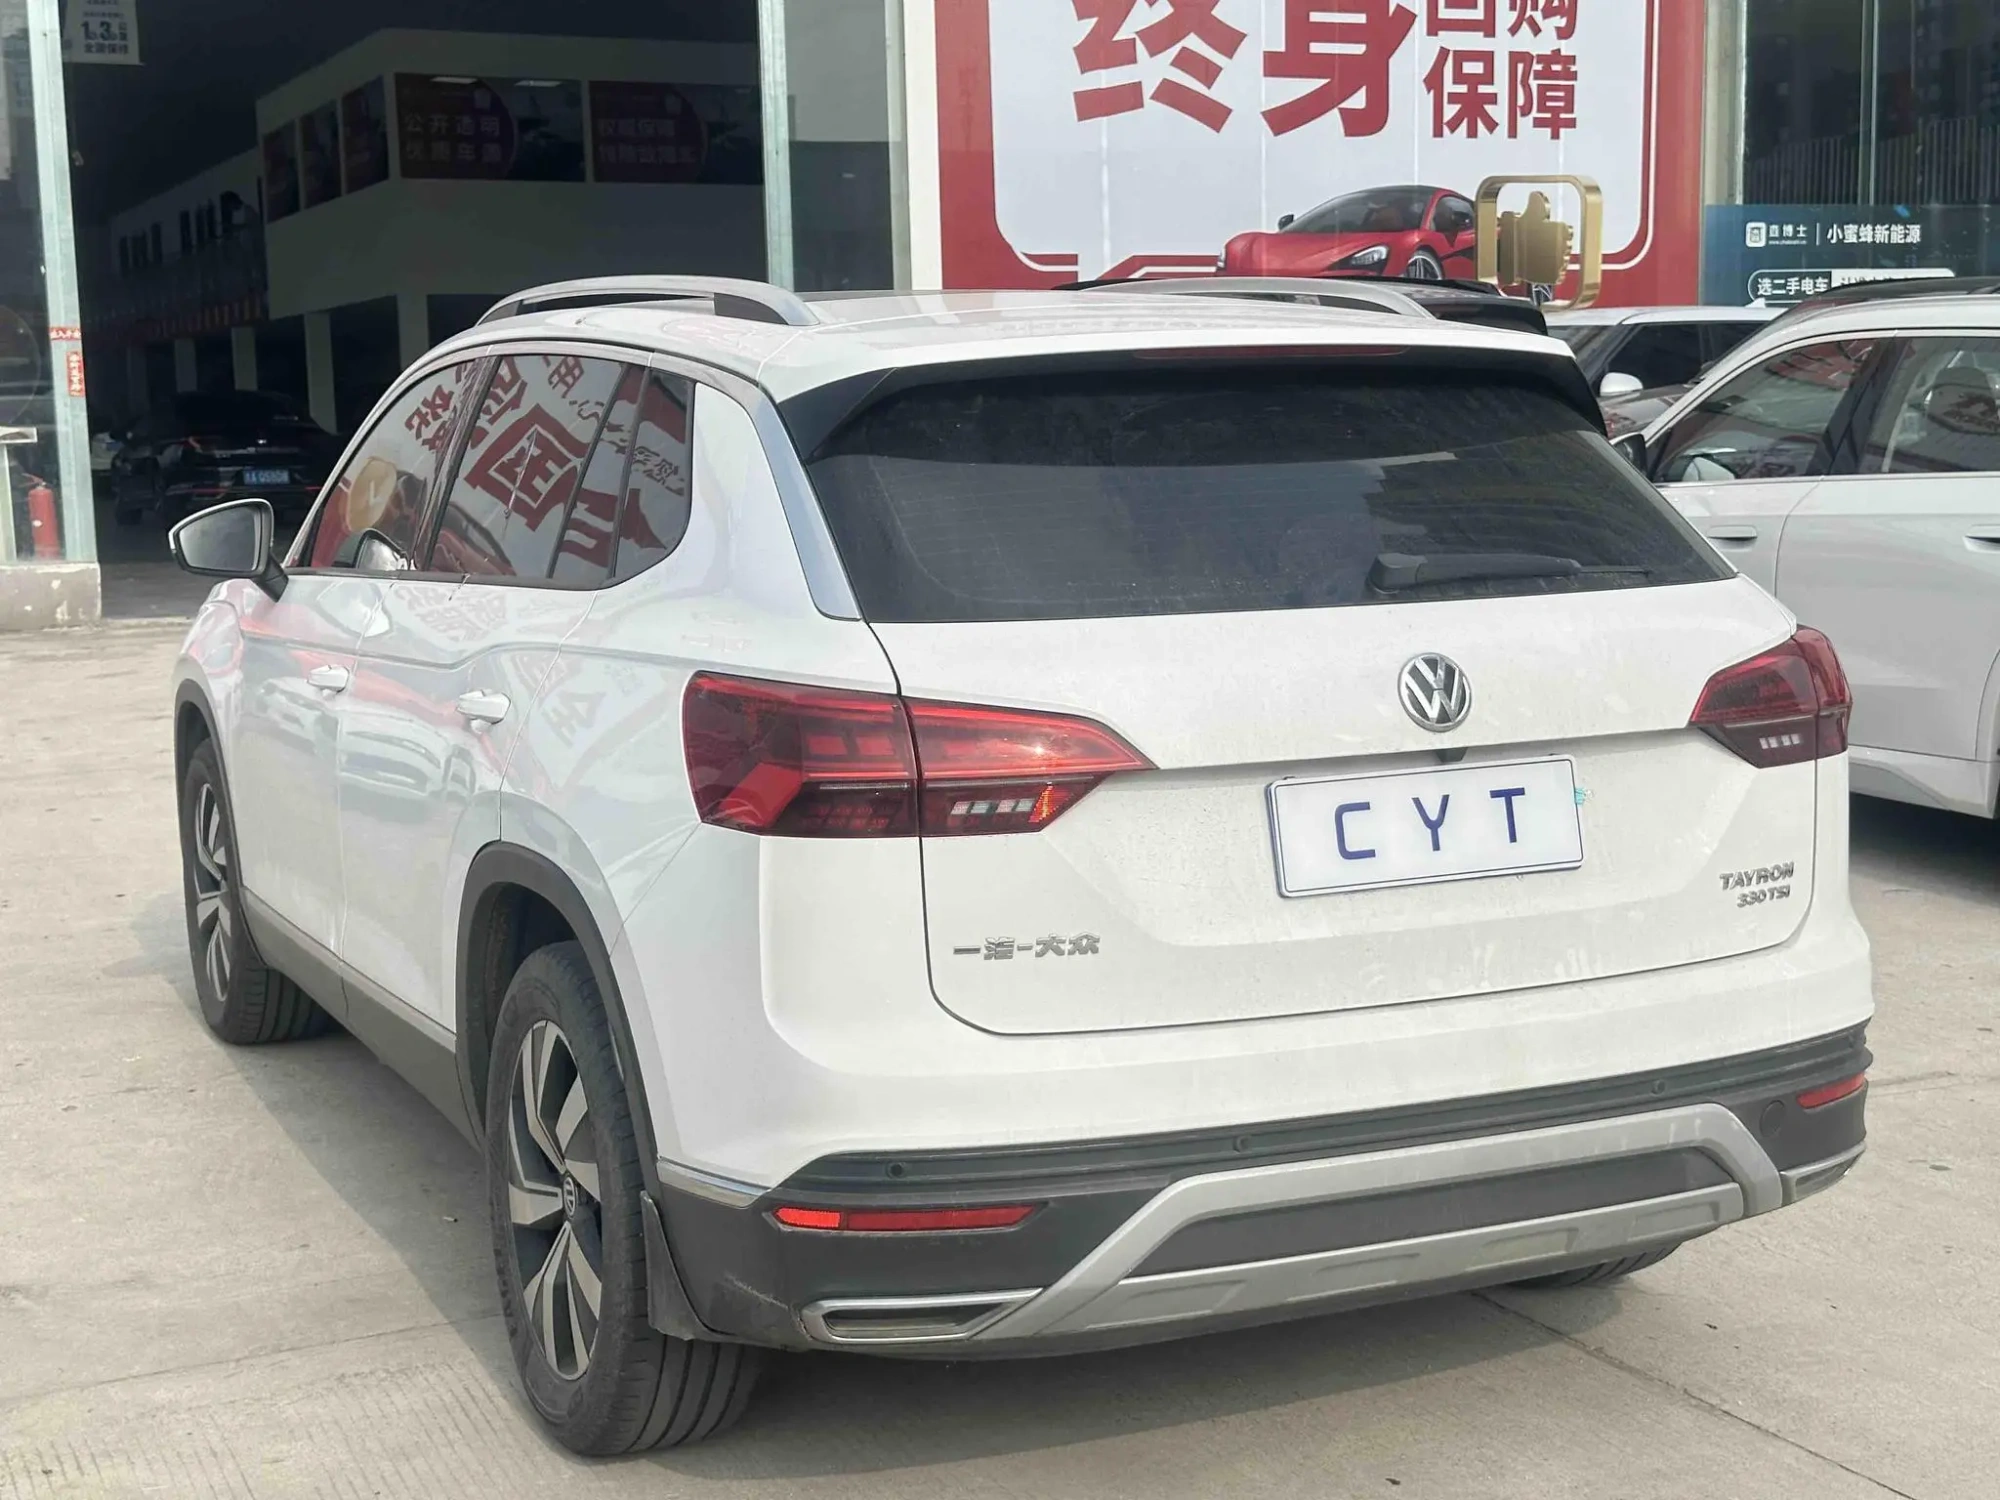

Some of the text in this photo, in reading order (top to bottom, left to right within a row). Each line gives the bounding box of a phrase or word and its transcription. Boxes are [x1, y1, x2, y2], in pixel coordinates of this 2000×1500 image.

[1072, 0, 1418, 138] 终身
[1423, 46, 1578, 140] 保障
[1826, 223, 1921, 244] 小蜜蜂新能源
[1757, 277, 1829, 296] 选二手电车
[1719, 860, 1795, 891] TAYRON
